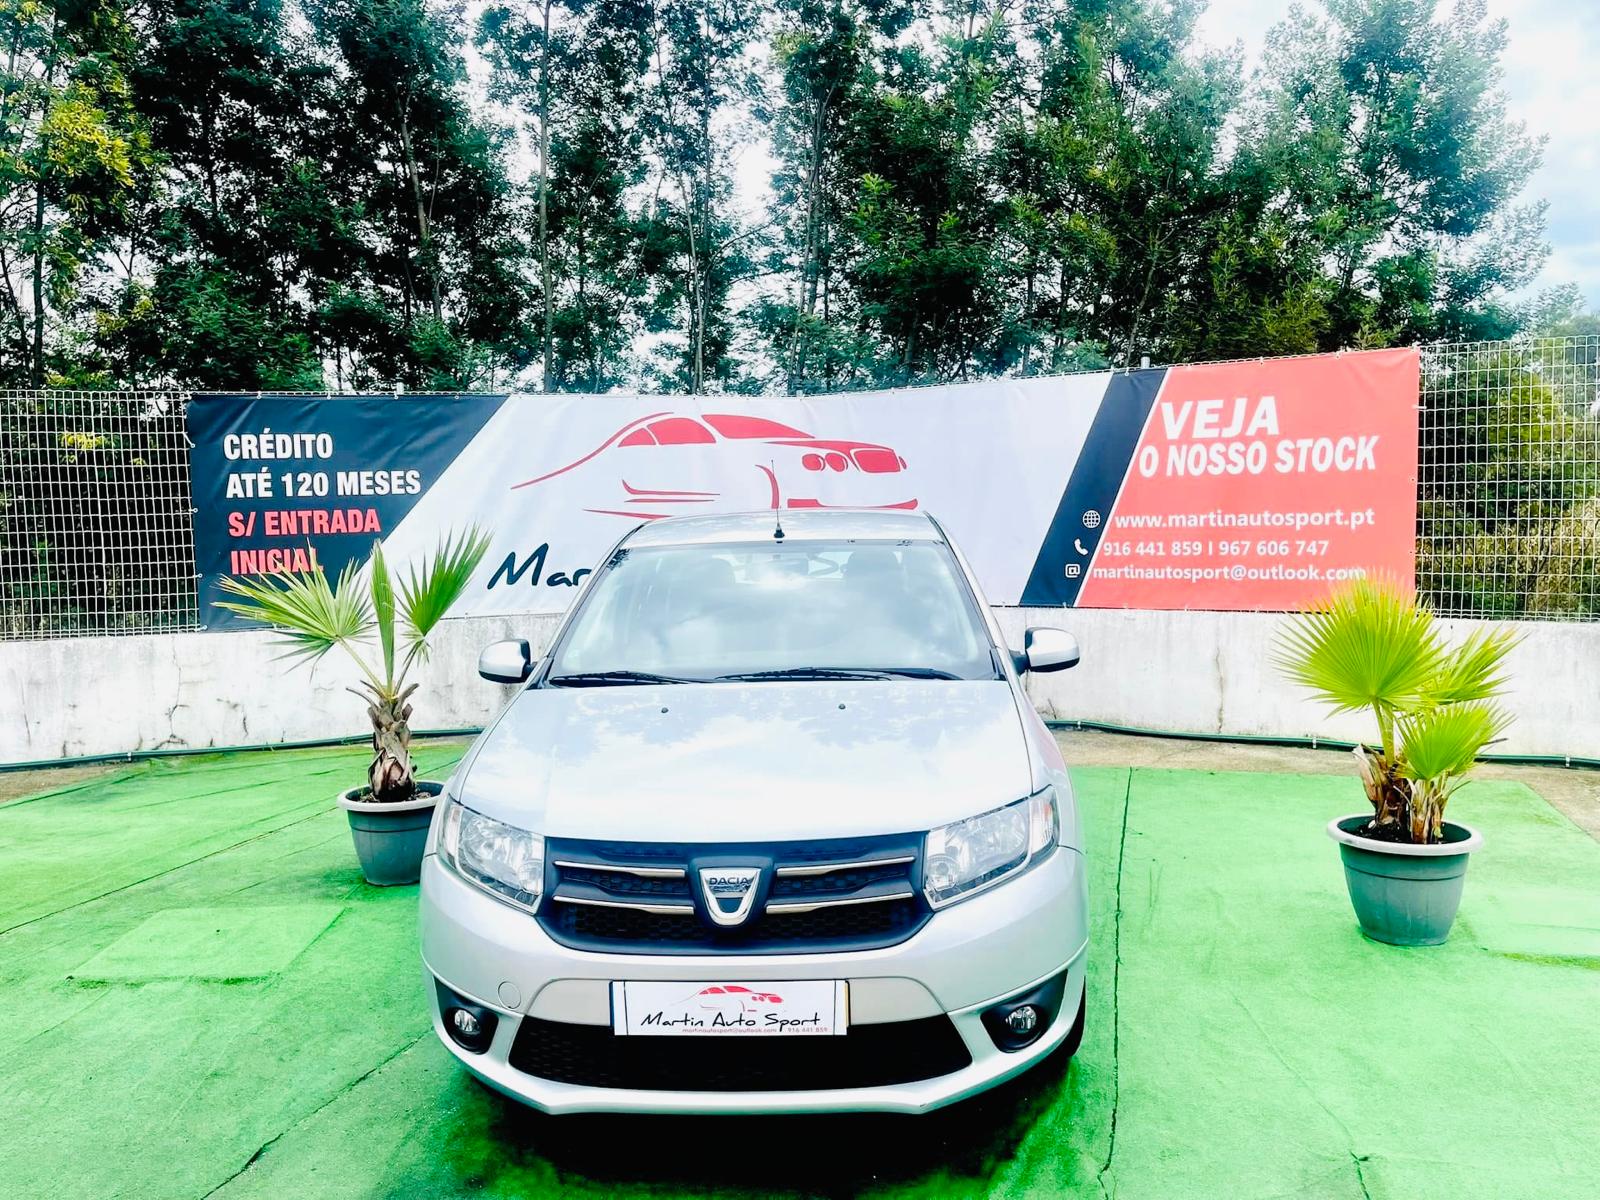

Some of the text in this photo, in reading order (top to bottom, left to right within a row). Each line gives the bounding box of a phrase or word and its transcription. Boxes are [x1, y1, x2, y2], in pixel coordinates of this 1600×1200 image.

[1160, 395, 1279, 440] VEJA
[223, 427, 334, 461] CRÉDITO
[1139, 435, 1380, 479] O NOSSO STOCK
[225, 466, 421, 499] ATÉ 120 MESES
[228, 508, 382, 538] S/ ENTRADA
[1114, 508, 1376, 530] www.martinautosport.pt
[231, 547, 324, 575] INICIAL
[1103, 541, 1131, 557] 916
[1135, 541, 1166, 557] 441
[1170, 541, 1202, 556] 859
[1218, 540, 1250, 556] 967
[1256, 540, 1290, 556] 606
[1295, 540, 1329, 556] 747
[1092, 564, 1367, 583] martinautosport@outlook.com
[709, 877, 750, 885] DACIA
[640, 1011, 821, 1032] Martin Auto Sport
